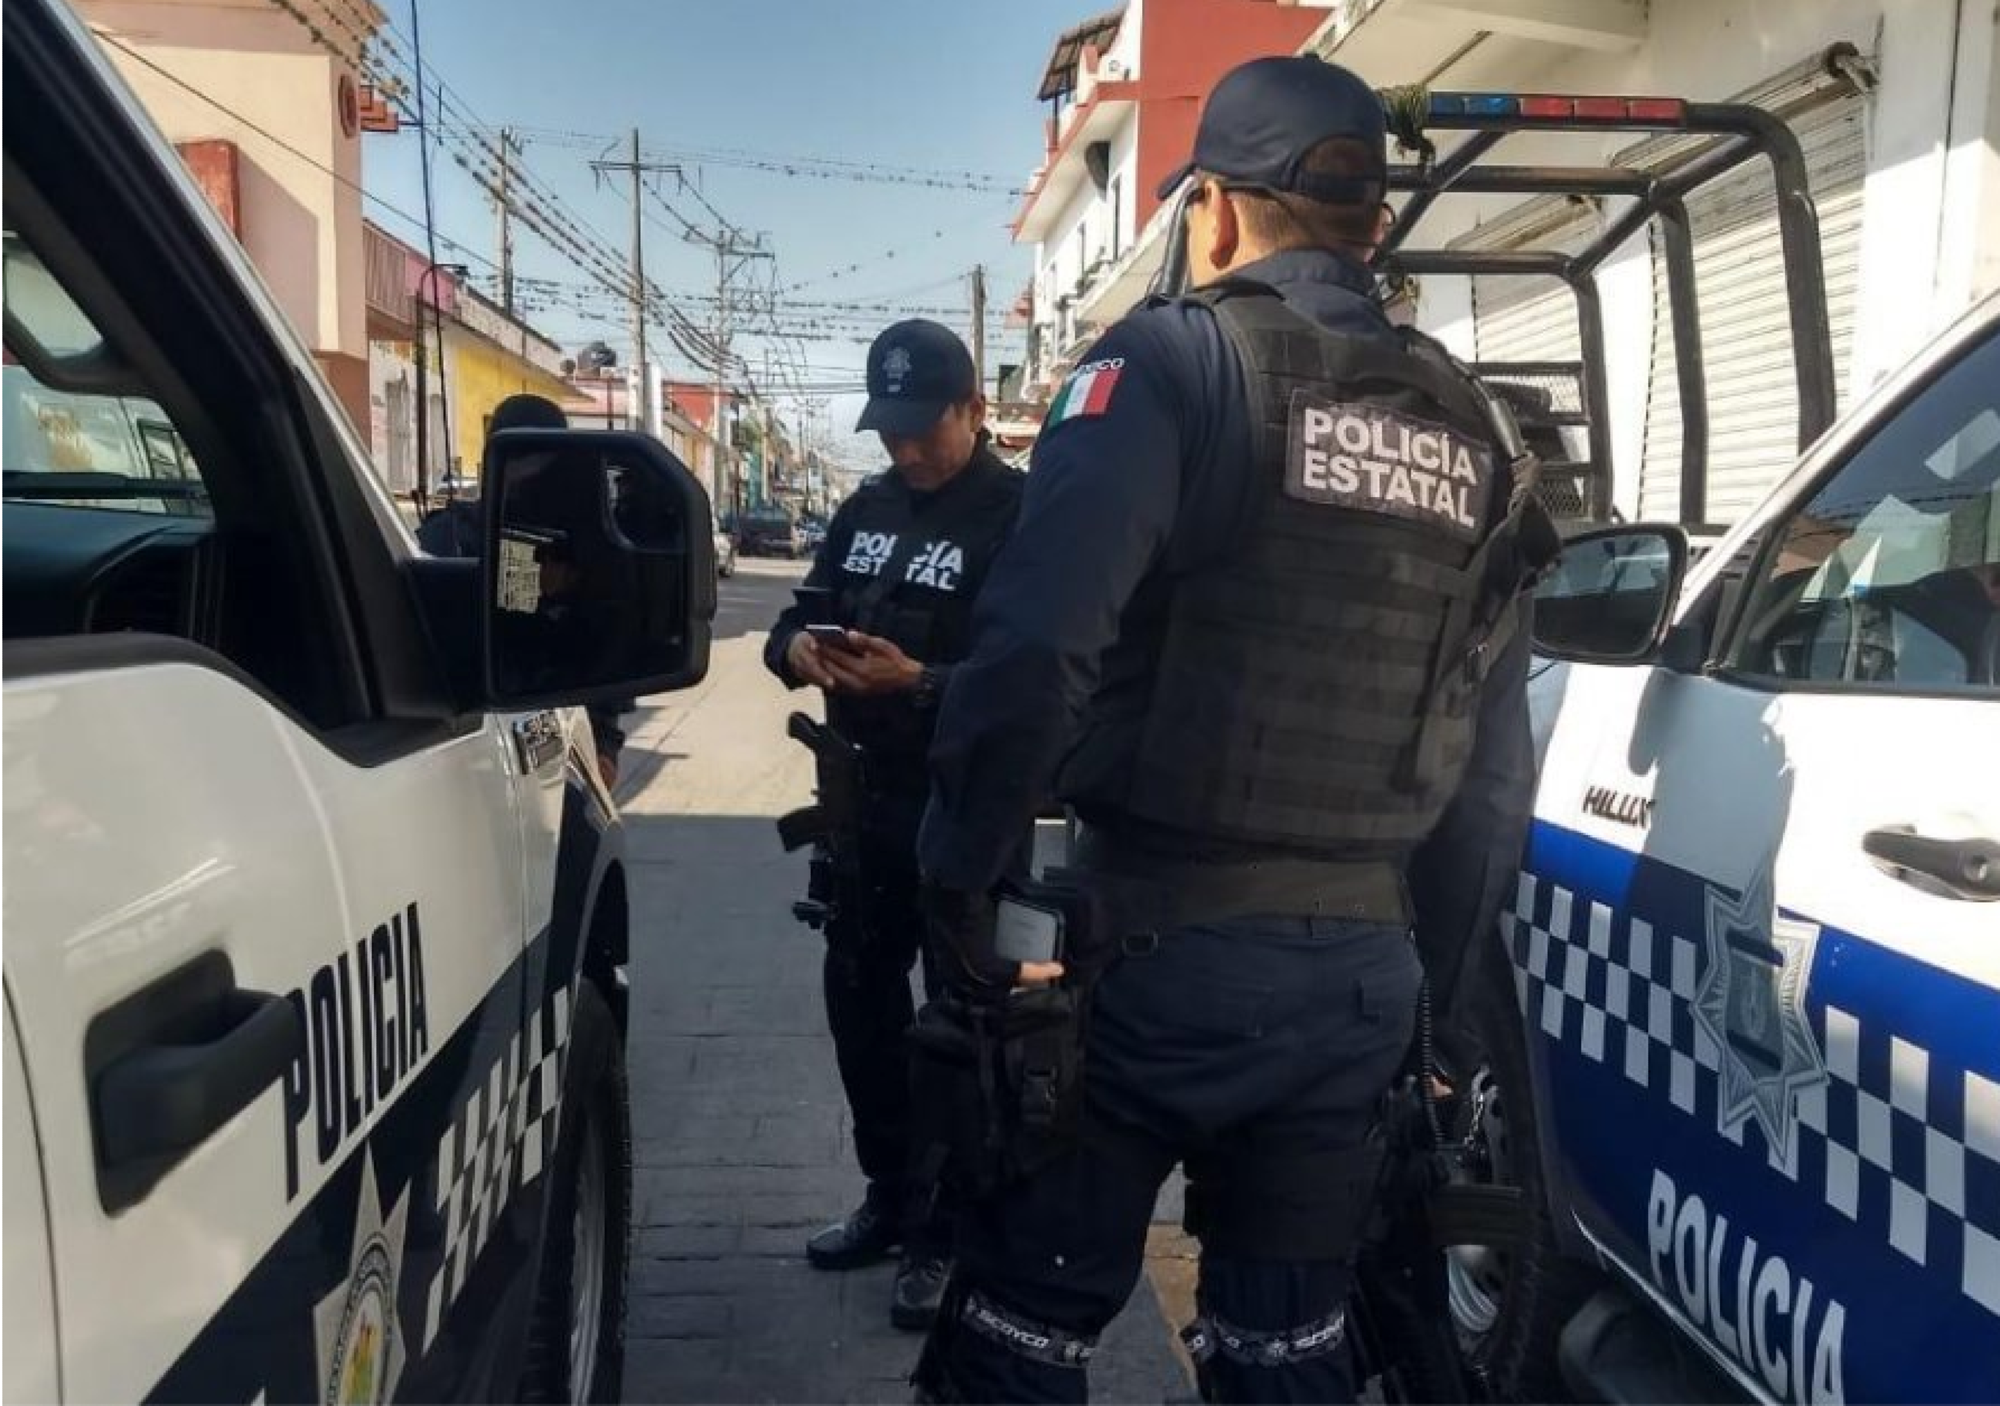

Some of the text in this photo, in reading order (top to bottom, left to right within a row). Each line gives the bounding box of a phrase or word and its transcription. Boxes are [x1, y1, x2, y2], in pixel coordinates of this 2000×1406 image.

[1303, 449, 1475, 528] ESTATAL
[842, 554, 956, 591] ESTTAL
[285, 901, 428, 1204] POLICIA
[1648, 1168, 1846, 1404] POLICIA
